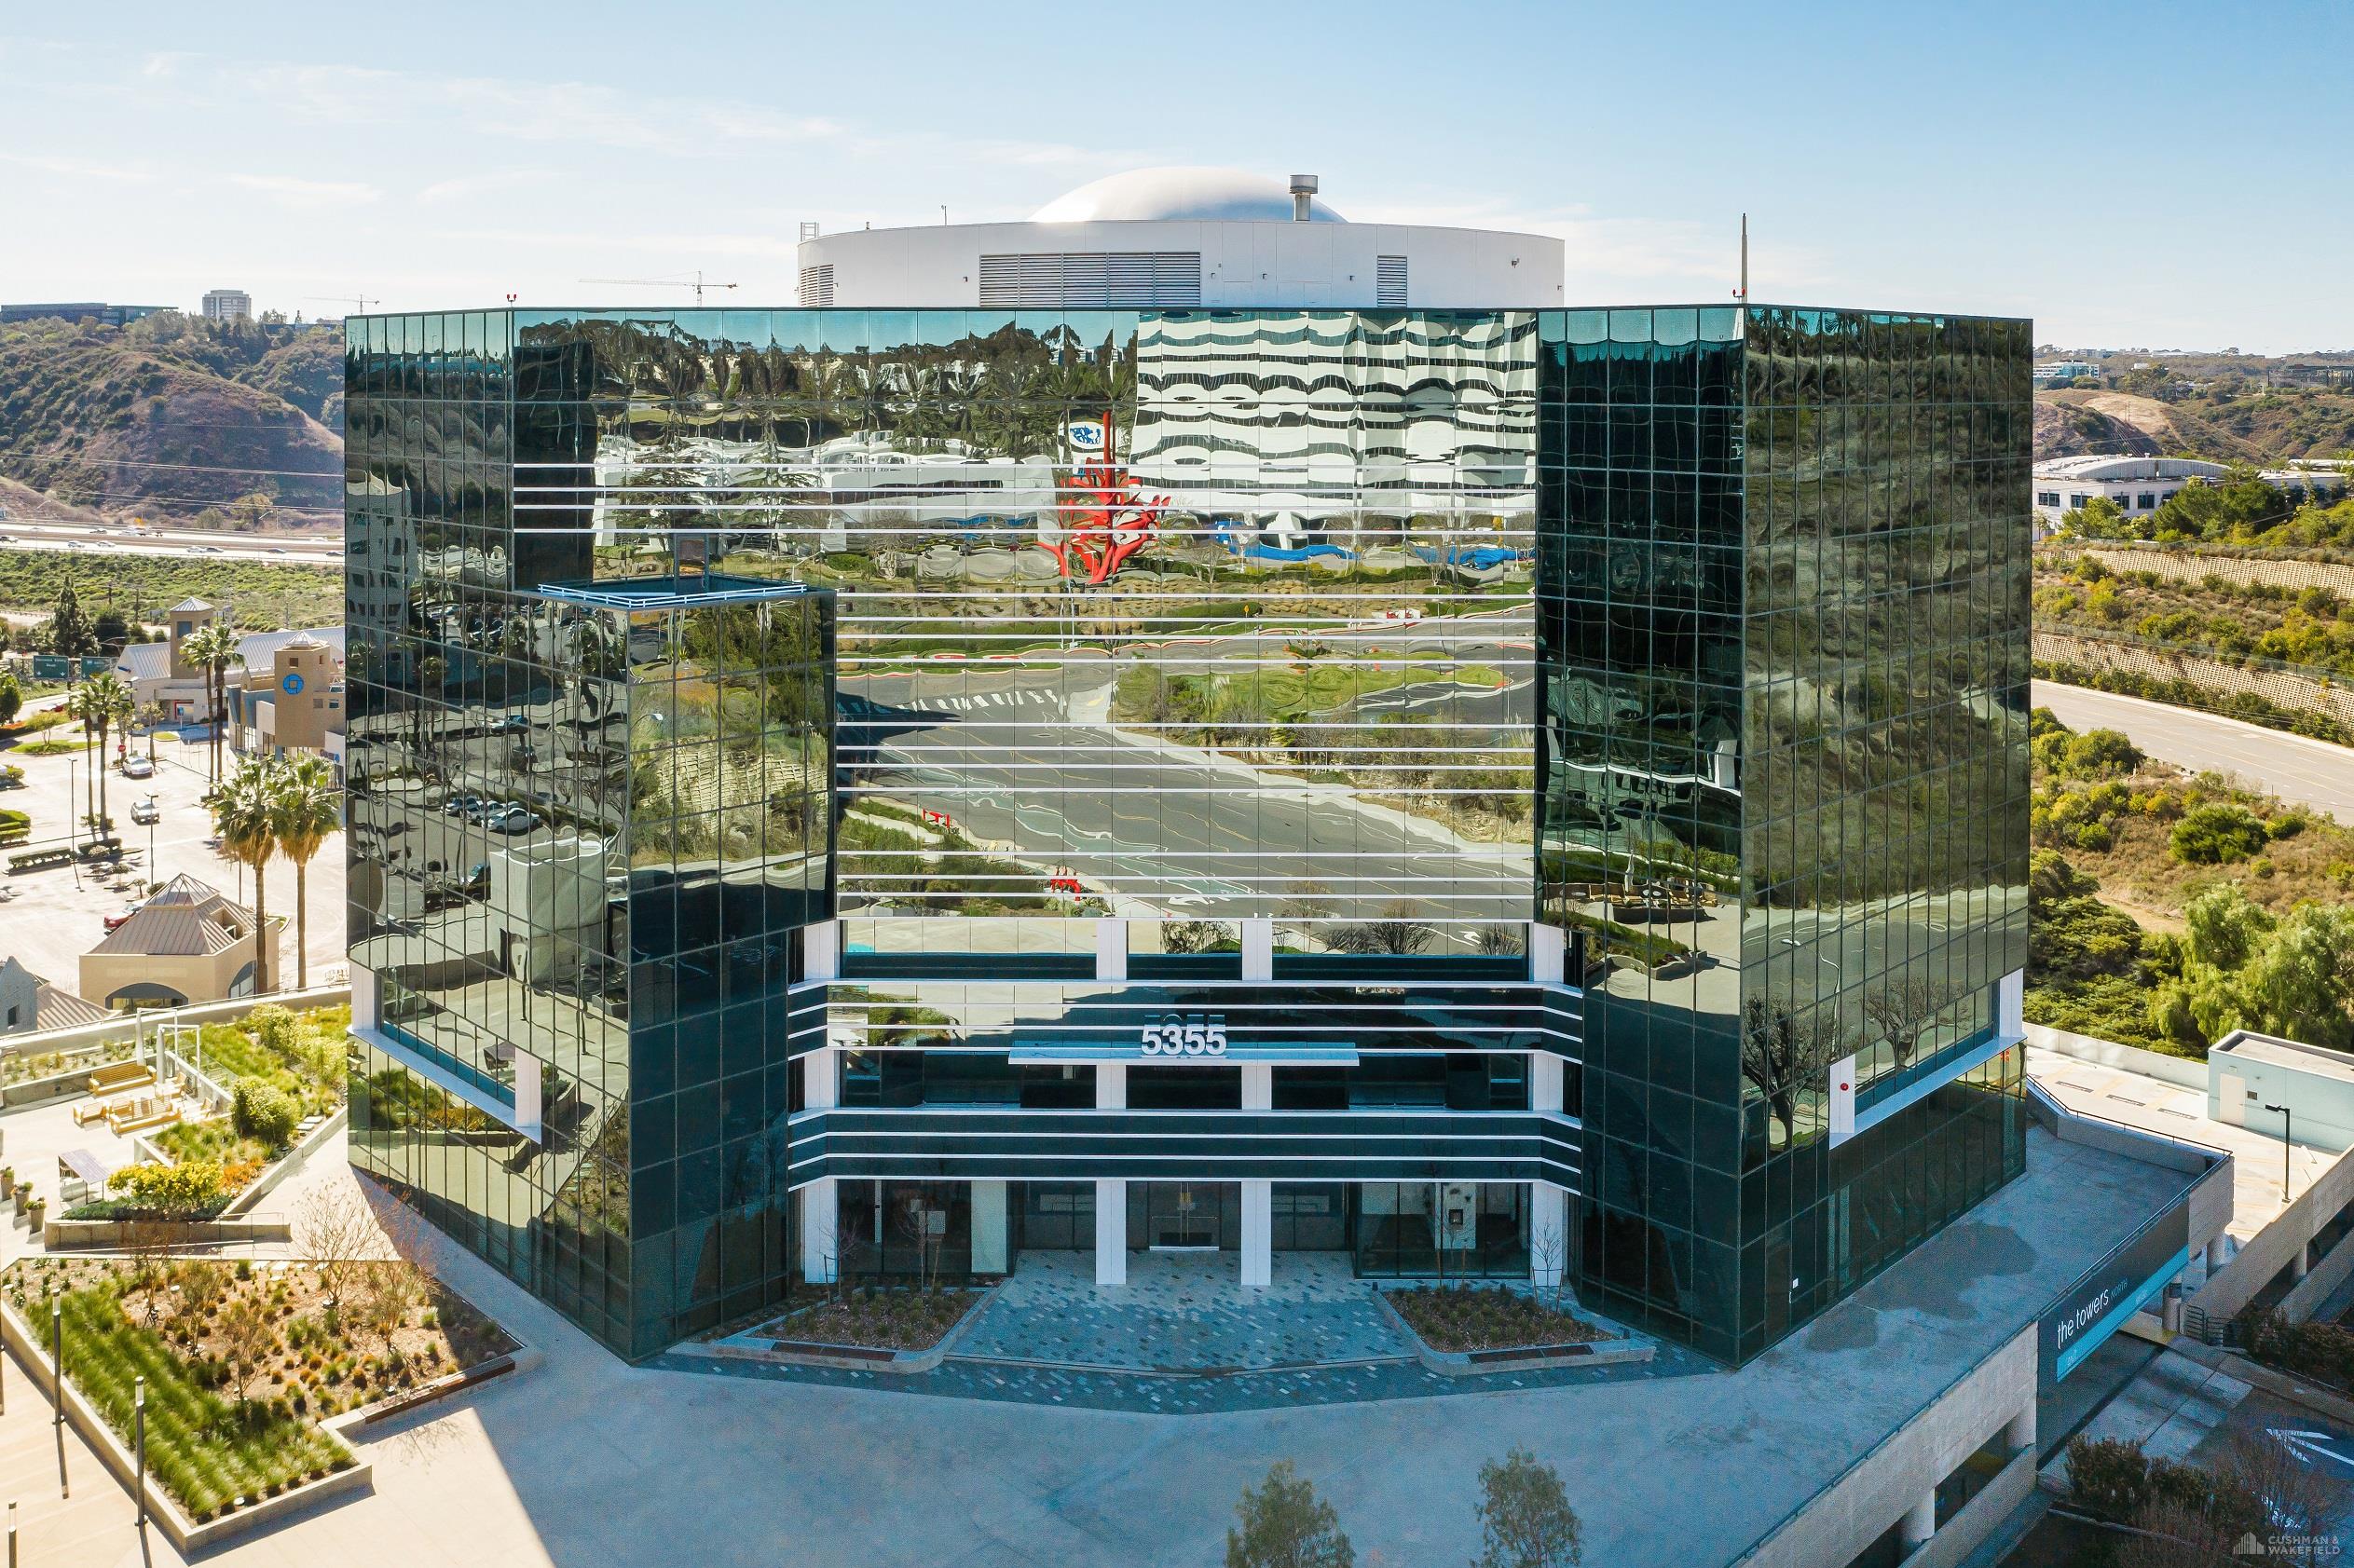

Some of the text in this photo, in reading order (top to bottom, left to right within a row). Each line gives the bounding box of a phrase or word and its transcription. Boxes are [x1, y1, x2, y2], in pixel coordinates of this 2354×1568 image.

[1142, 1023, 1227, 1056] 5355
[2057, 1320, 2074, 1350] the
[2075, 1288, 2109, 1329] towers
